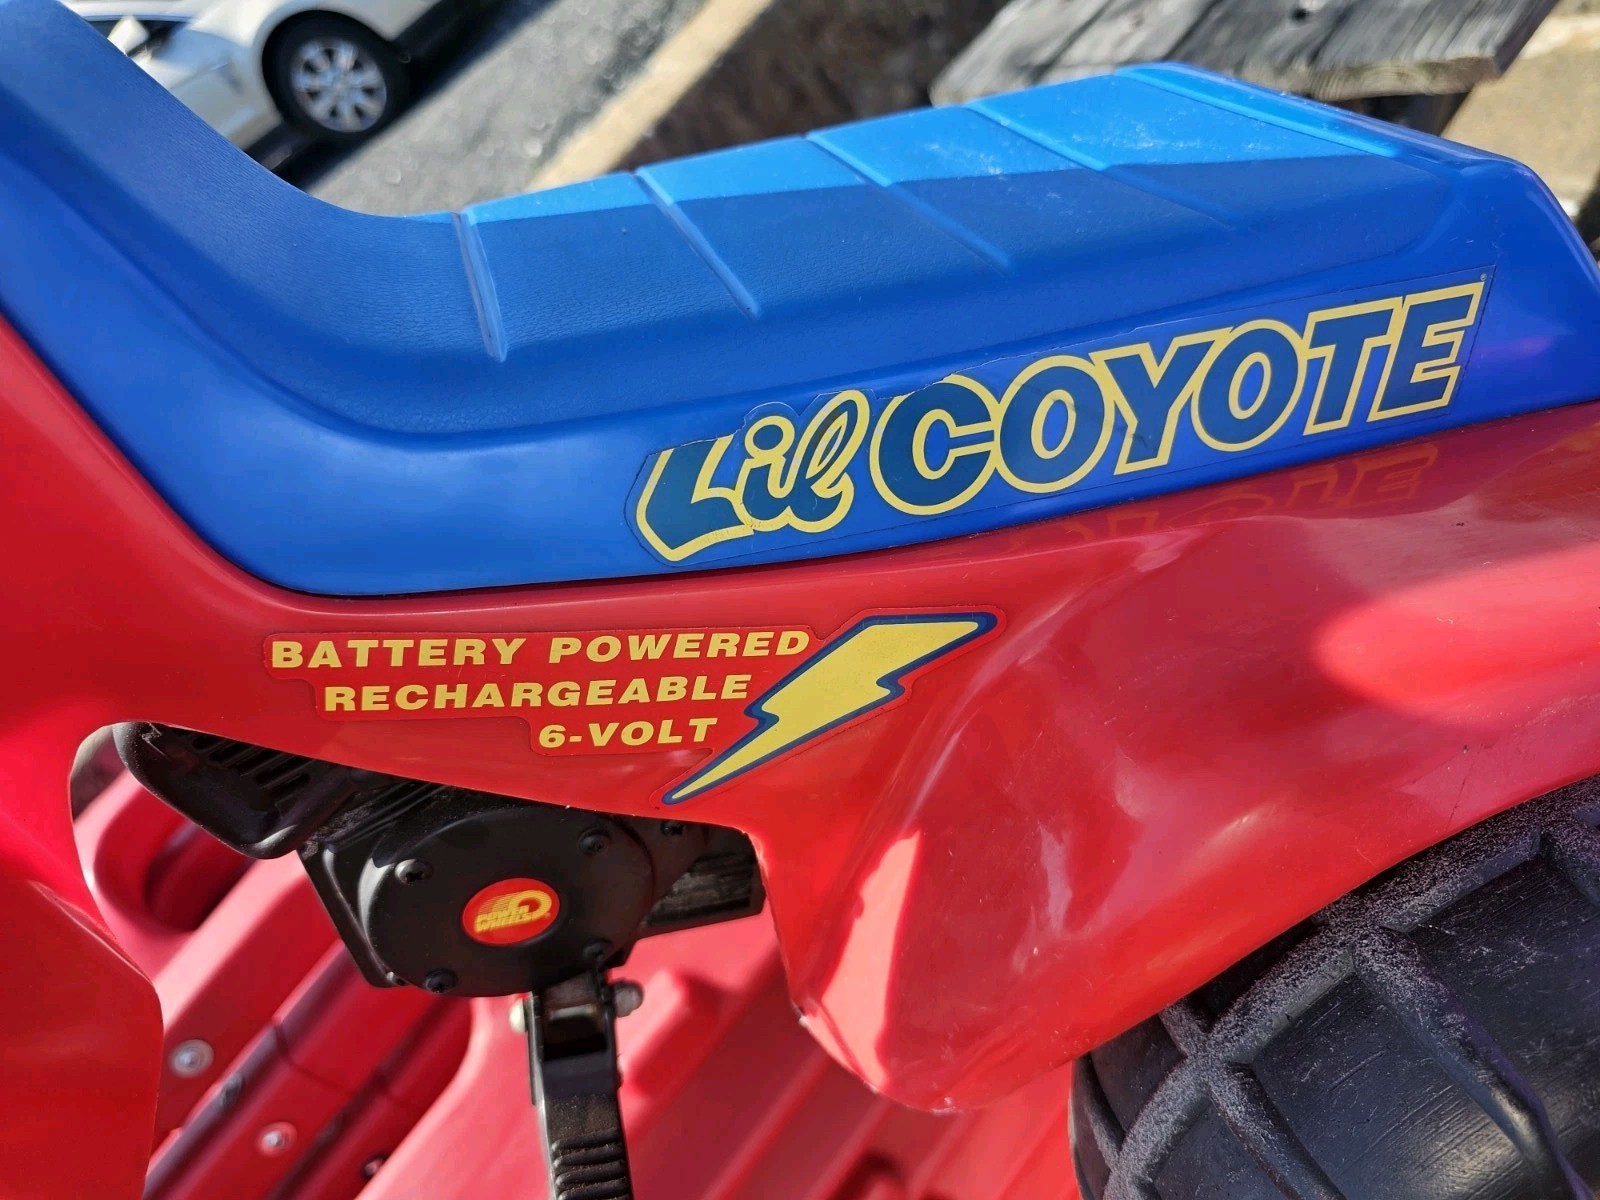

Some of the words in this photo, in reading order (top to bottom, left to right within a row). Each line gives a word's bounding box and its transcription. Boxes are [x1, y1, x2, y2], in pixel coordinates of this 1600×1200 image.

[636, 389, 871, 562] Lil
[870, 281, 1484, 515] COYOTE
[271, 637, 527, 669] BATTERY
[548, 630, 809, 664] POWERED
[324, 674, 752, 711] RECHARGEABLE
[538, 717, 718, 749] 6-VOLT
